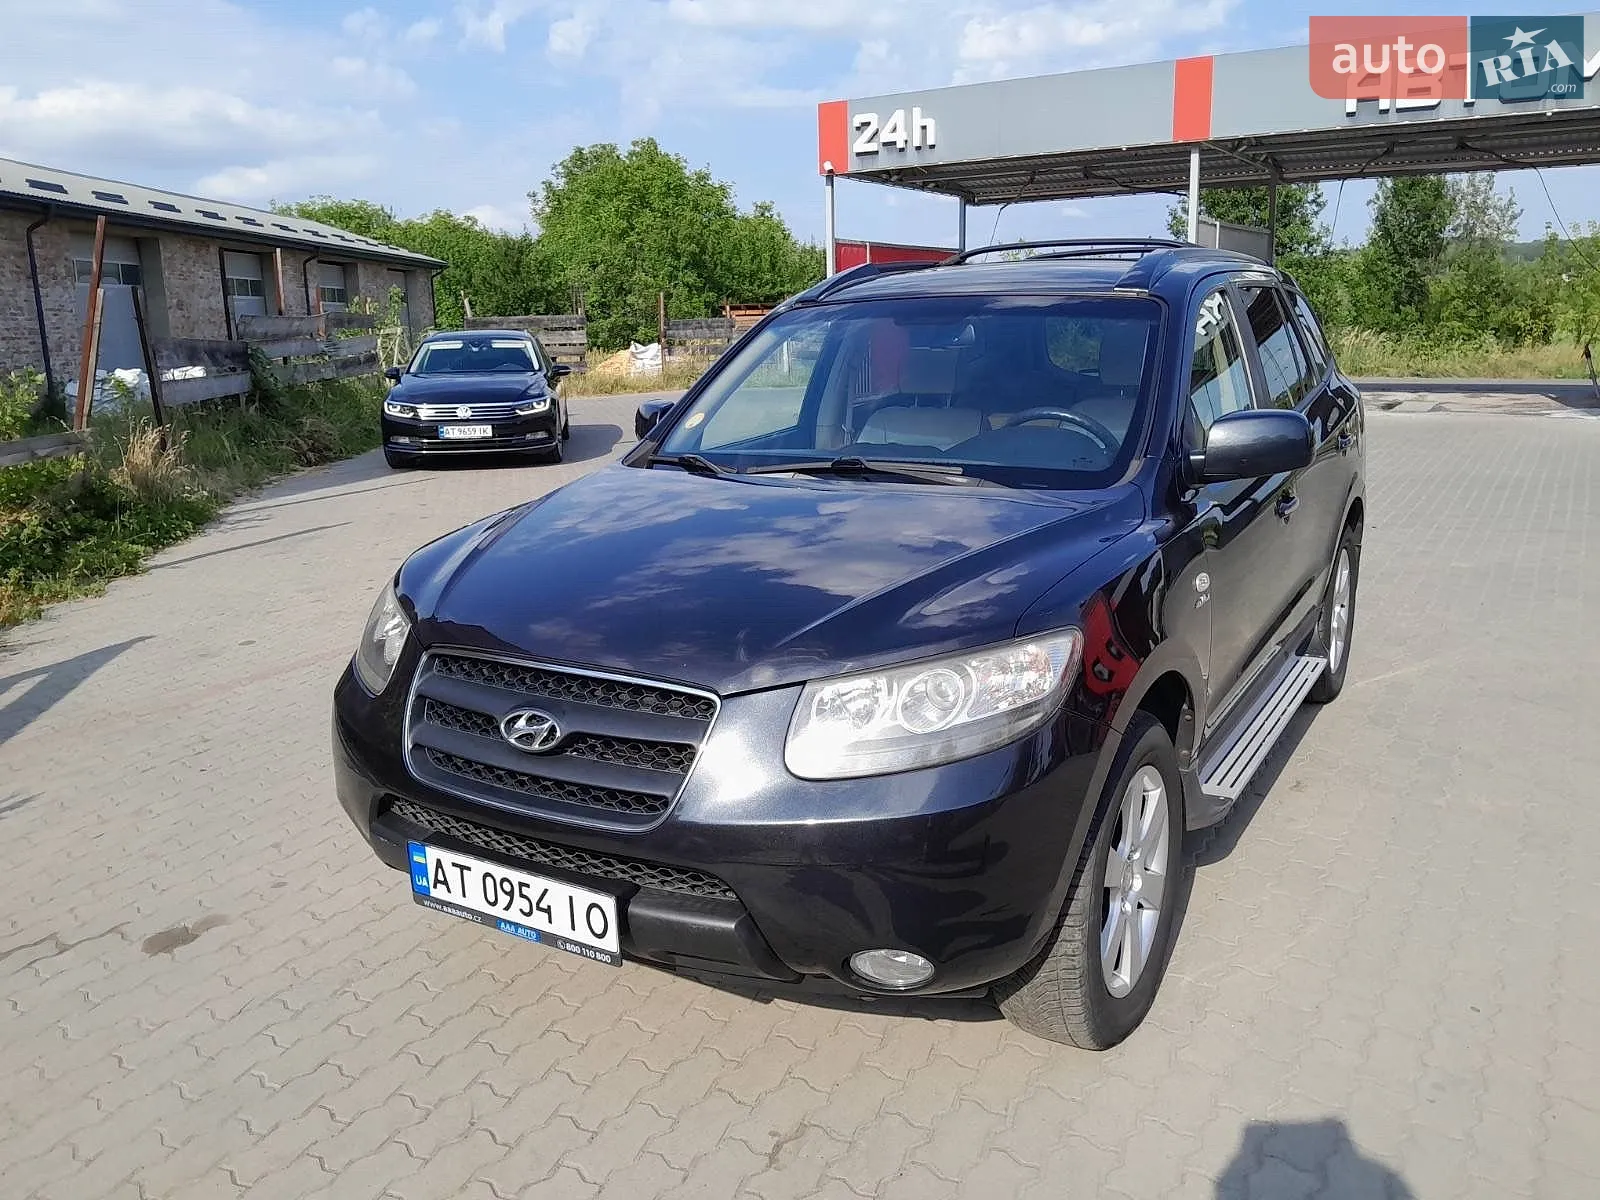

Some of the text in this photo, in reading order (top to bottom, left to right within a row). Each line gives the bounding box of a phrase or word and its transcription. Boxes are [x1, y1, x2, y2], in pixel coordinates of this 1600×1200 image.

[852, 106, 937, 156] 24h
[444, 426, 490, 437] AT 9659 IK
[415, 875, 429, 888] UA
[432, 857, 609, 940] AT 0954 IO
[500, 922, 538, 941] AAA AUTO
[565, 942, 612, 964] 800 110 800
